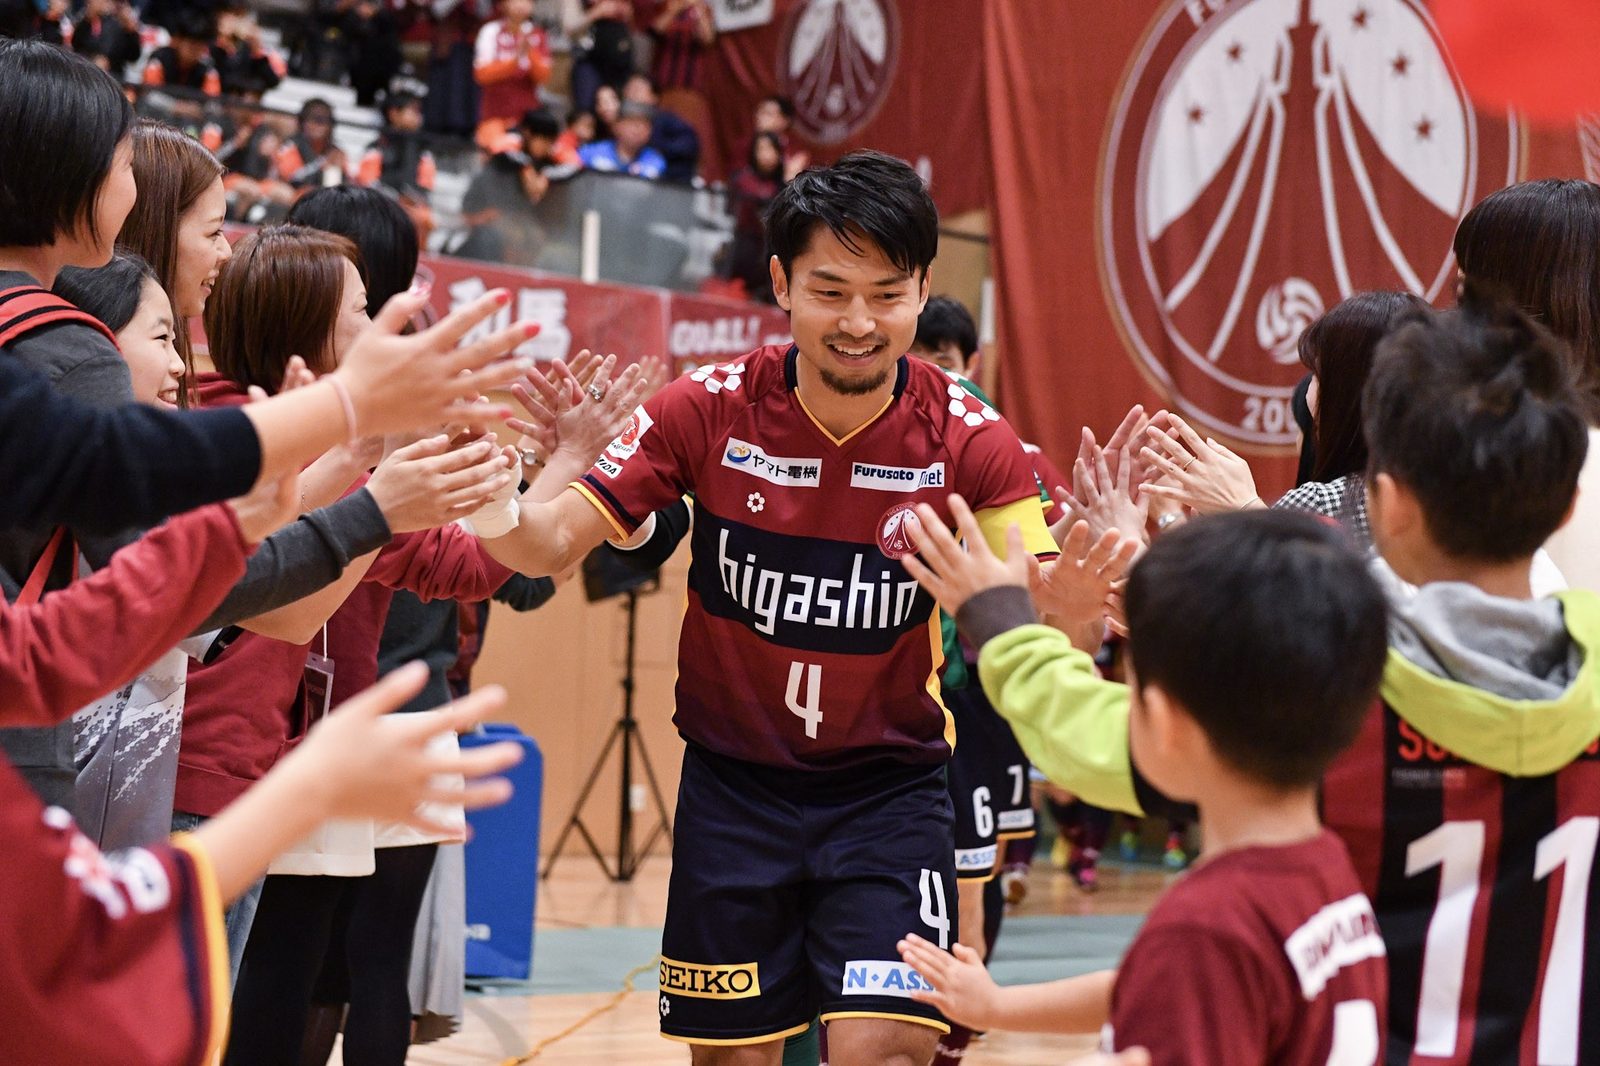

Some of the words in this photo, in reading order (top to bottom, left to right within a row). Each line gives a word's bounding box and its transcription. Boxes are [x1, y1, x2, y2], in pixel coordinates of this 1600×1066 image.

[753, 454, 818, 479] ヤマト電機
[854, 465, 915, 481] Furusato
[718, 528, 918, 636] higashin
[785, 661, 823, 739] 4
[1007, 765, 1024, 805] 7
[973, 786, 994, 838] 6
[919, 869, 950, 949] 4
[660, 961, 753, 993] SEIKO
